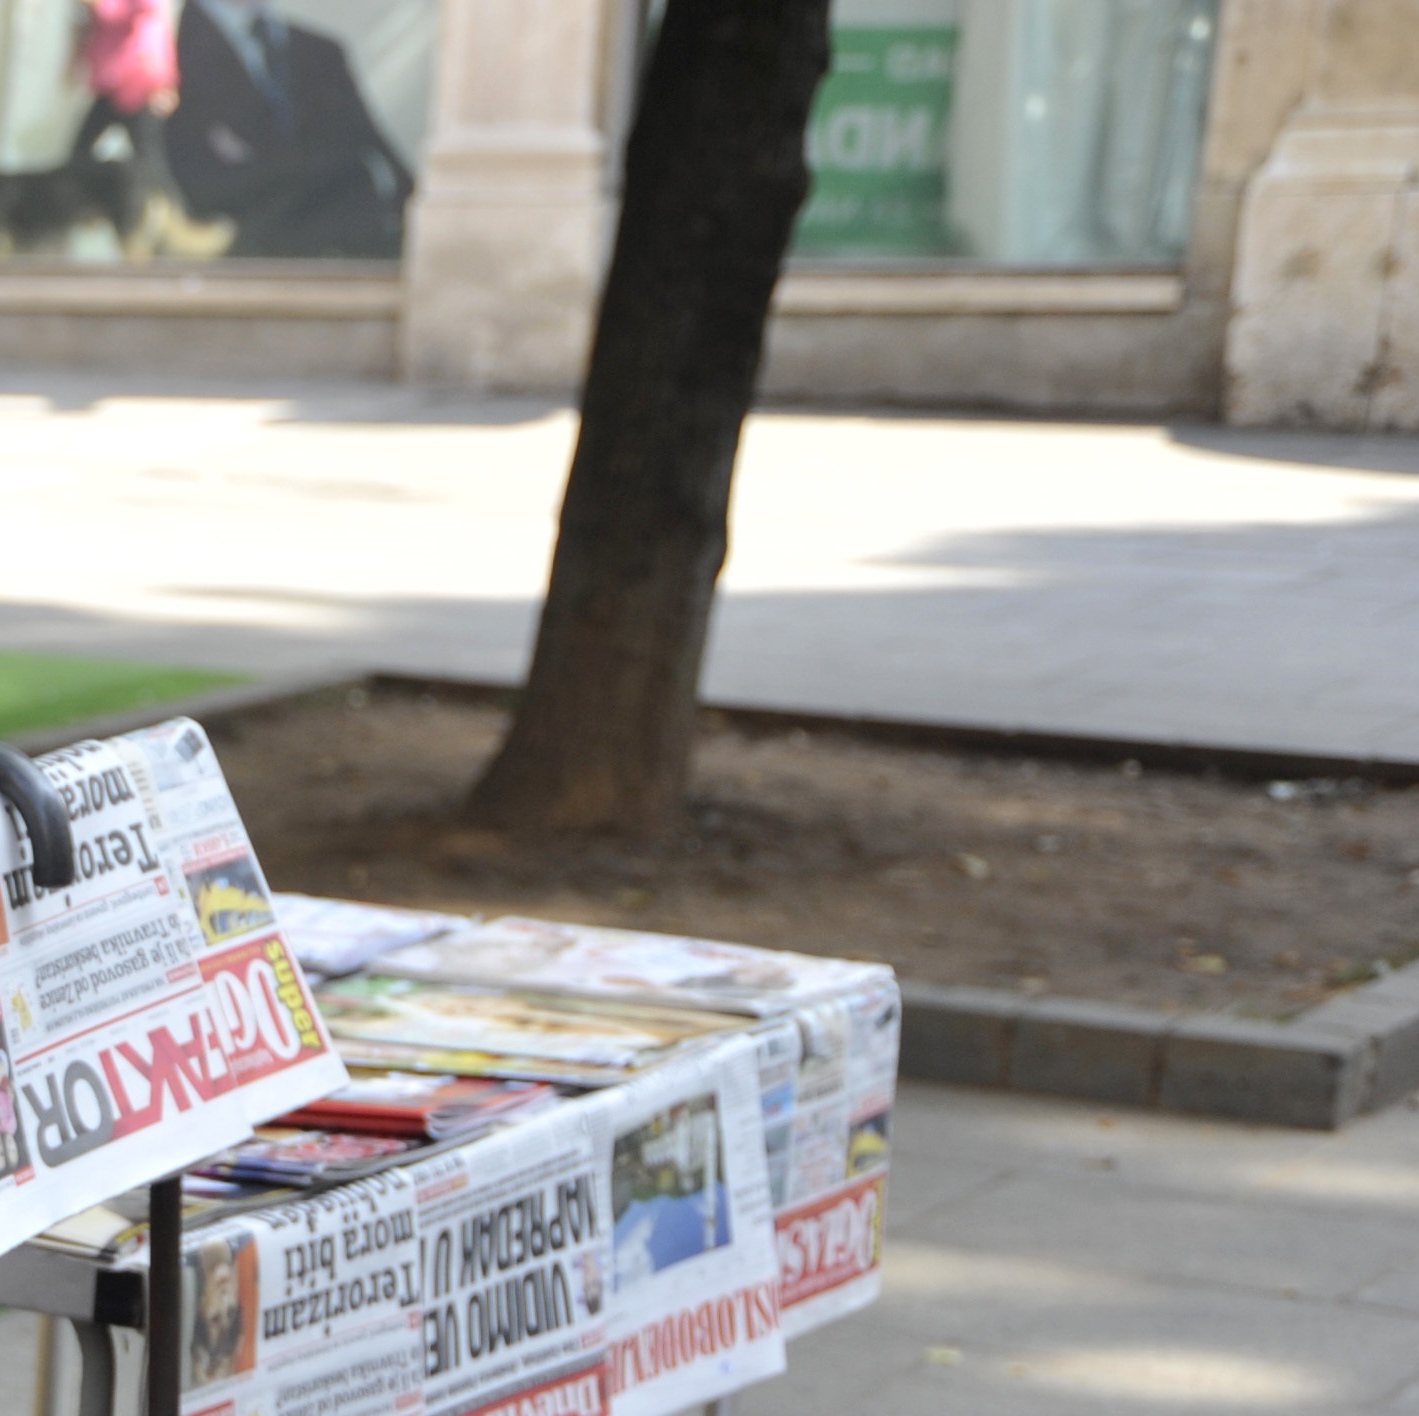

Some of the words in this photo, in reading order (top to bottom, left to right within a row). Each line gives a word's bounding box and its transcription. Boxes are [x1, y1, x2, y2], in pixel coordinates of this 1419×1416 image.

[101, 918, 169, 954] Travnika
[38, 982, 76, 1012] Zenice
[89, 948, 150, 995] gasovod
[264, 940, 321, 1050] super
[342, 1207, 415, 1262] mora
[284, 1235, 336, 1298] biti
[262, 1261, 419, 1342] Terorizam
